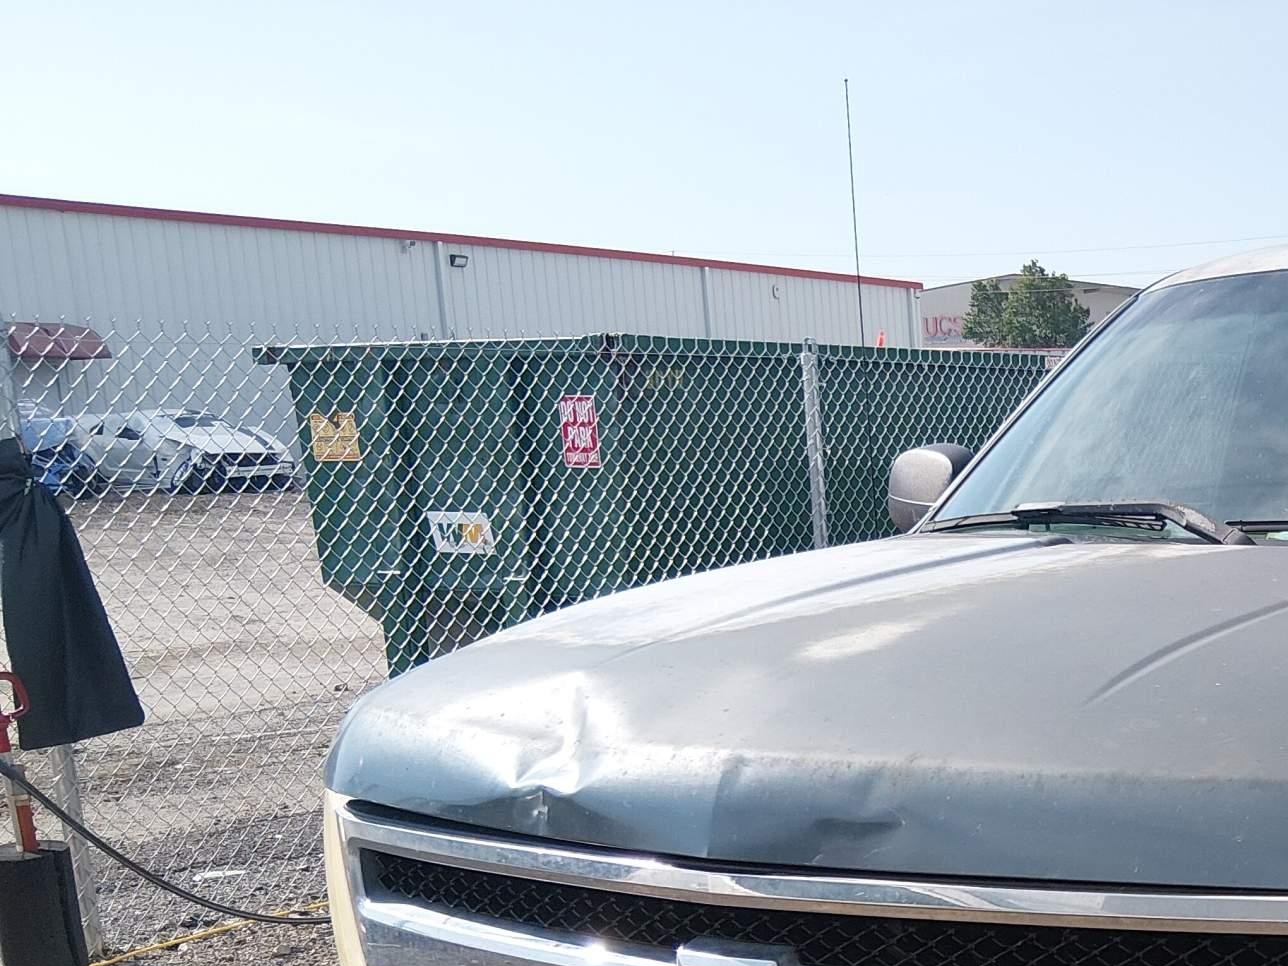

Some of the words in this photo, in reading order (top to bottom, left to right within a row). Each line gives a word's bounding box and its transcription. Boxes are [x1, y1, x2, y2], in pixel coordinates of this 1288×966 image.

[560, 401, 574, 423] DO
[574, 401, 594, 424] NOT
[567, 426, 594, 448] PARK
